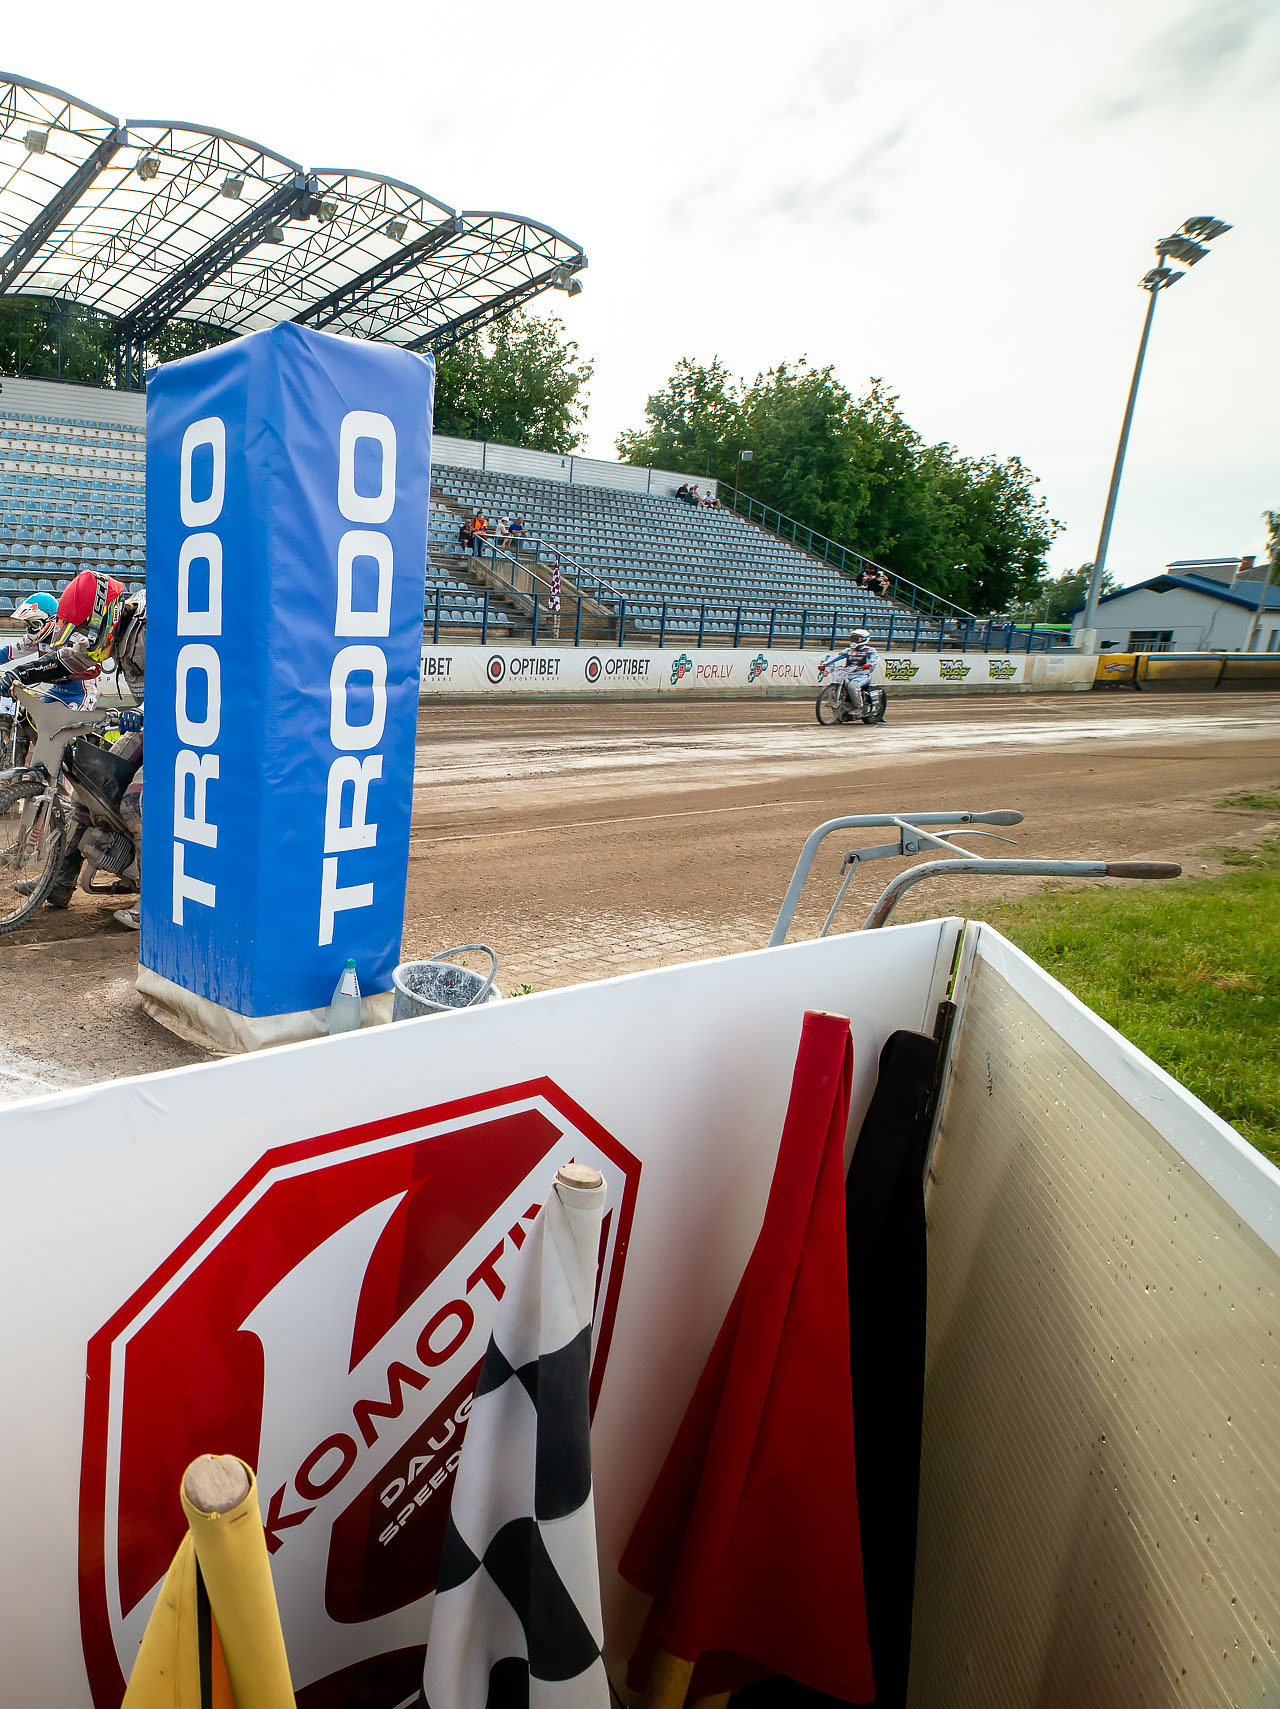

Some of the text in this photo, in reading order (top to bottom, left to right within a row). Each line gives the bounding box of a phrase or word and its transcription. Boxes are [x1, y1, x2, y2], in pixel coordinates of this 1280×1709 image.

[172, 416, 226, 927] TRODO
[318, 410, 398, 947] TRODO
[421, 657, 453, 675] IBET
[509, 658, 561, 676] OPTIBET
[605, 658, 650, 675] OPTIBET
[696, 664, 734, 679] PCR.LV
[771, 664, 805, 678] PCR.LV
[262, 1203, 543, 1556] KOMOTI
[381, 1391, 474, 1509] DAUG
[378, 1444, 463, 1547] SPEED
